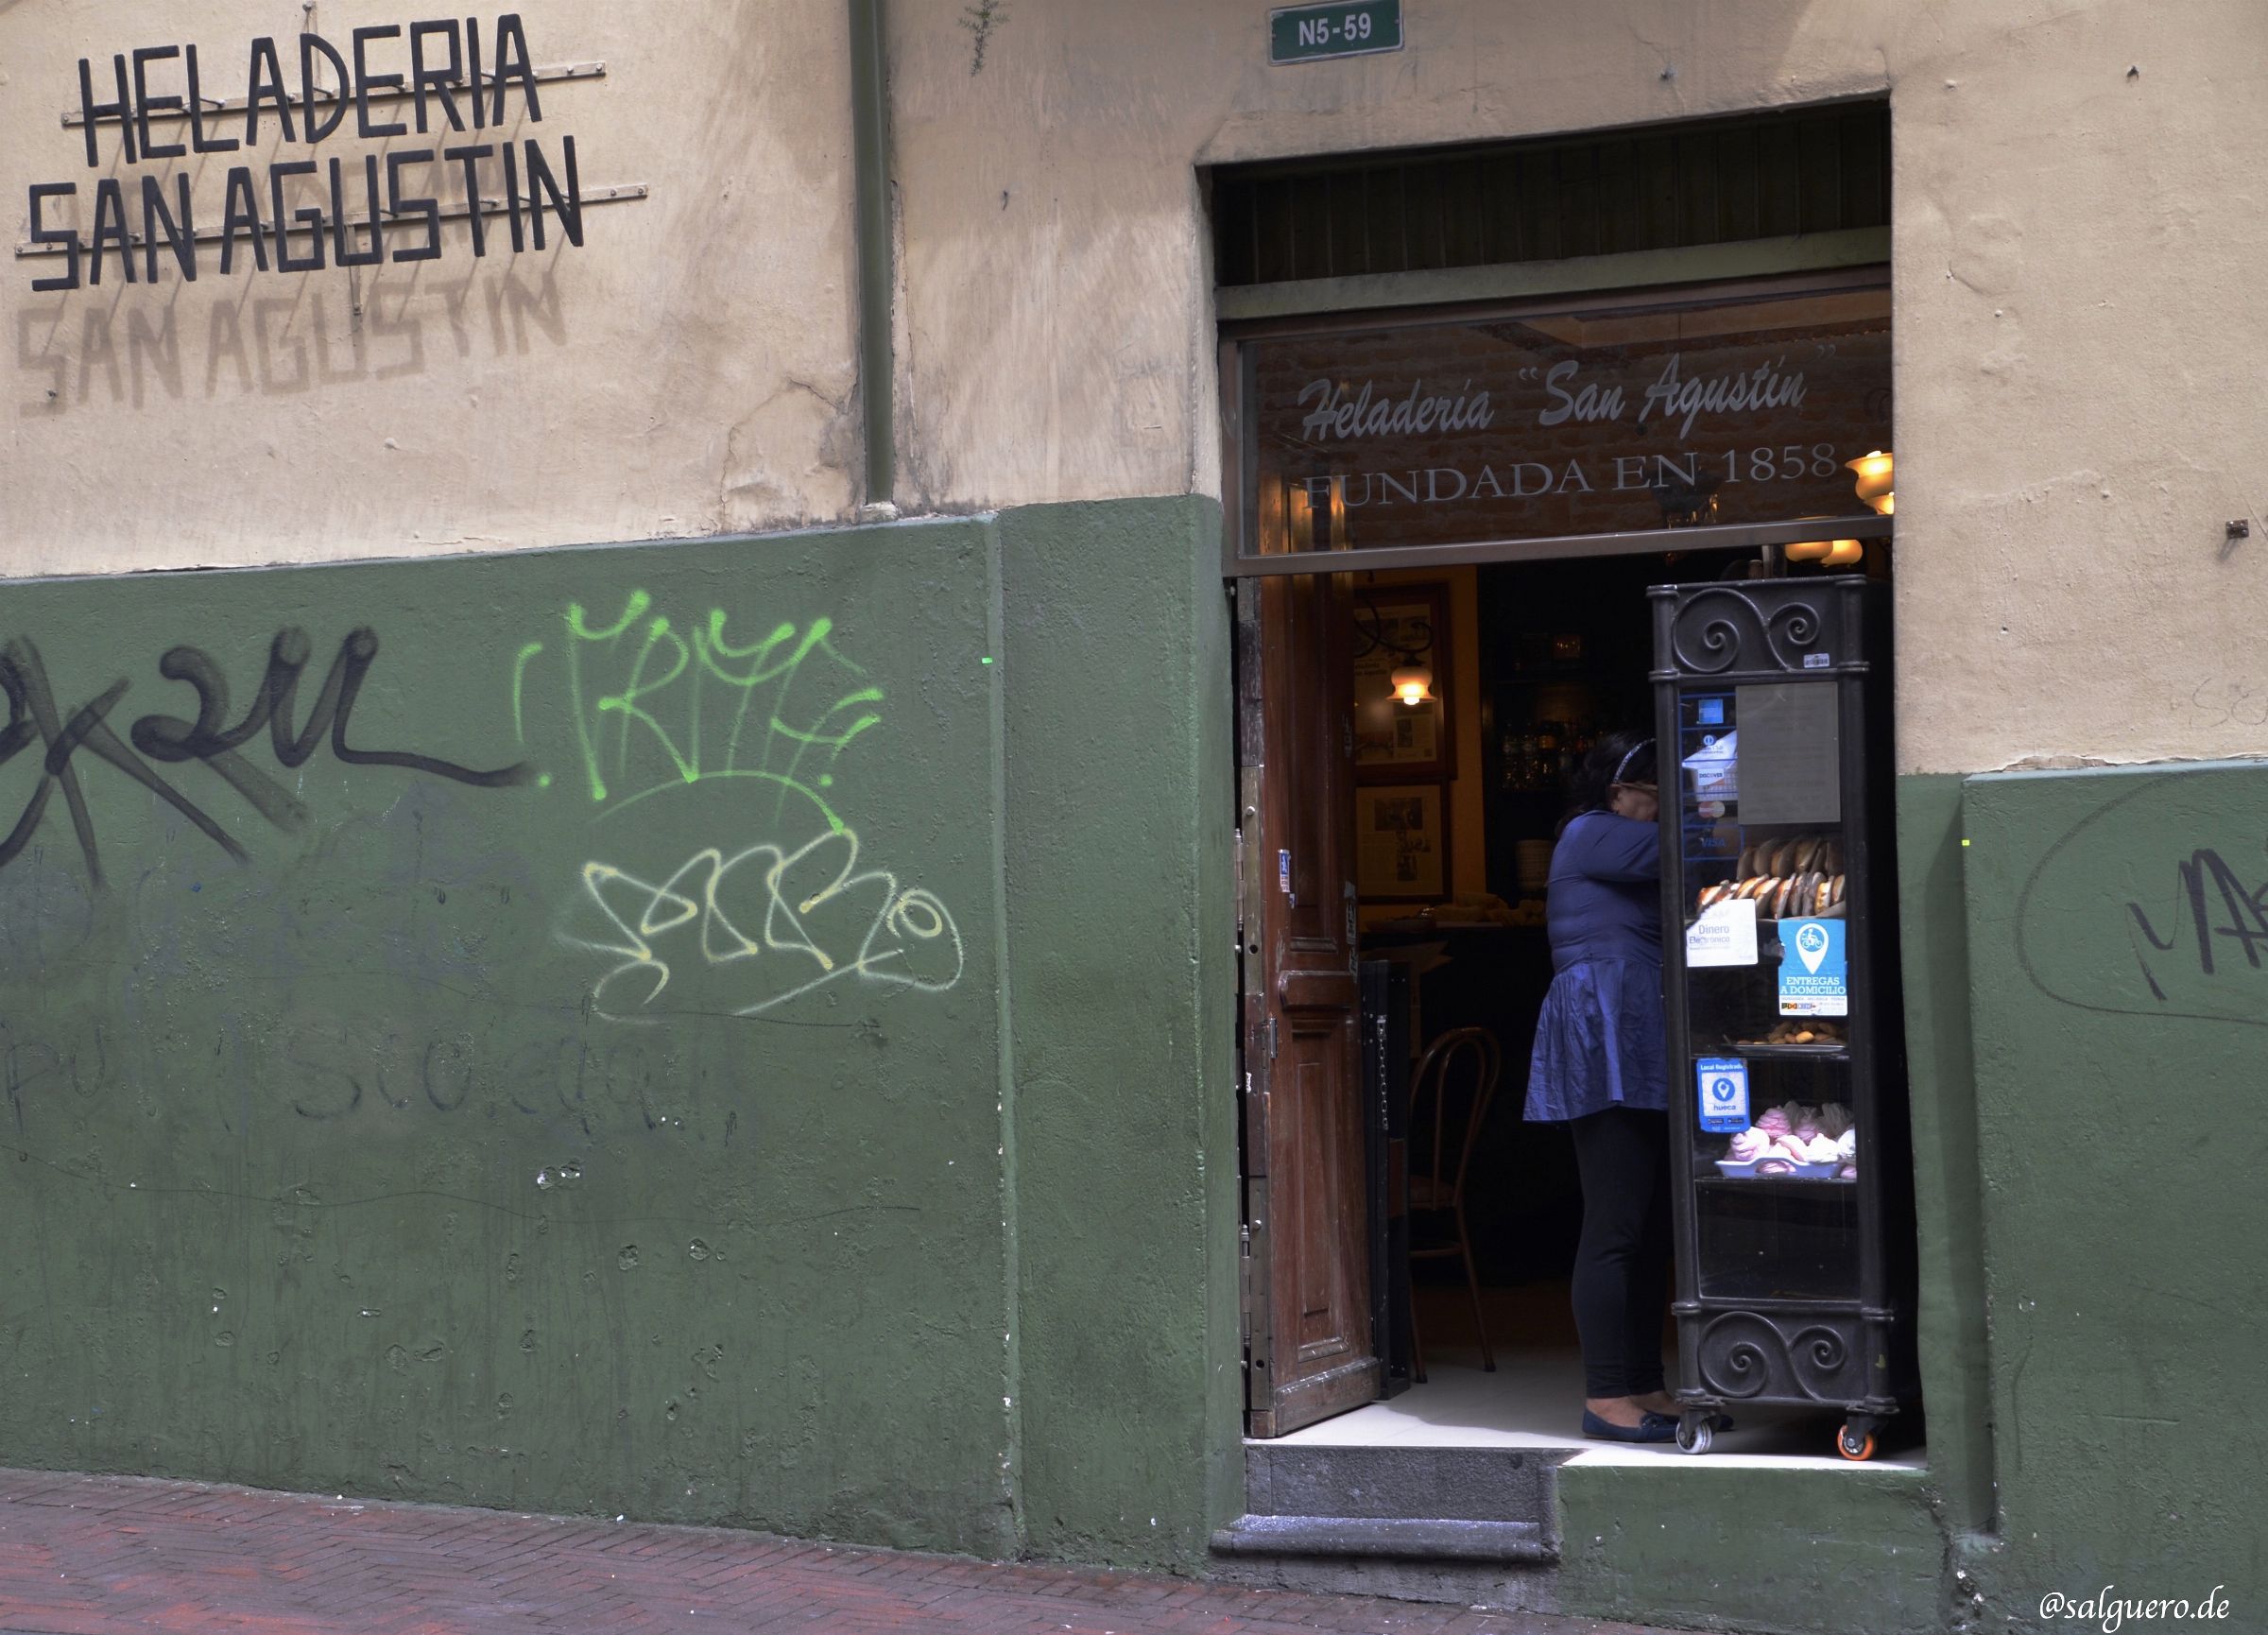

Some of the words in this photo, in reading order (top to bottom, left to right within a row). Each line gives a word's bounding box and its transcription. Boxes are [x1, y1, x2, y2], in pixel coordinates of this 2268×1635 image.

[1298, 12, 1371, 46] N5-59
[78, 14, 542, 167] HELADERIA
[29, 172, 197, 292] SAN
[220, 135, 584, 274] AGUSTIN
[1297, 378, 1494, 441] Heladería
[1303, 461, 1594, 508] FUNDADA
[1612, 453, 1698, 491] EN
[1721, 442, 1837, 484] 1858
[1701, 837, 1727, 848] VISA
[1698, 924, 1730, 935] Dinero
[1780, 986, 1788, 994] A
[1790, 986, 1847, 994] DOMICILIO
[1786, 976, 1840, 986] ENTREGAS
